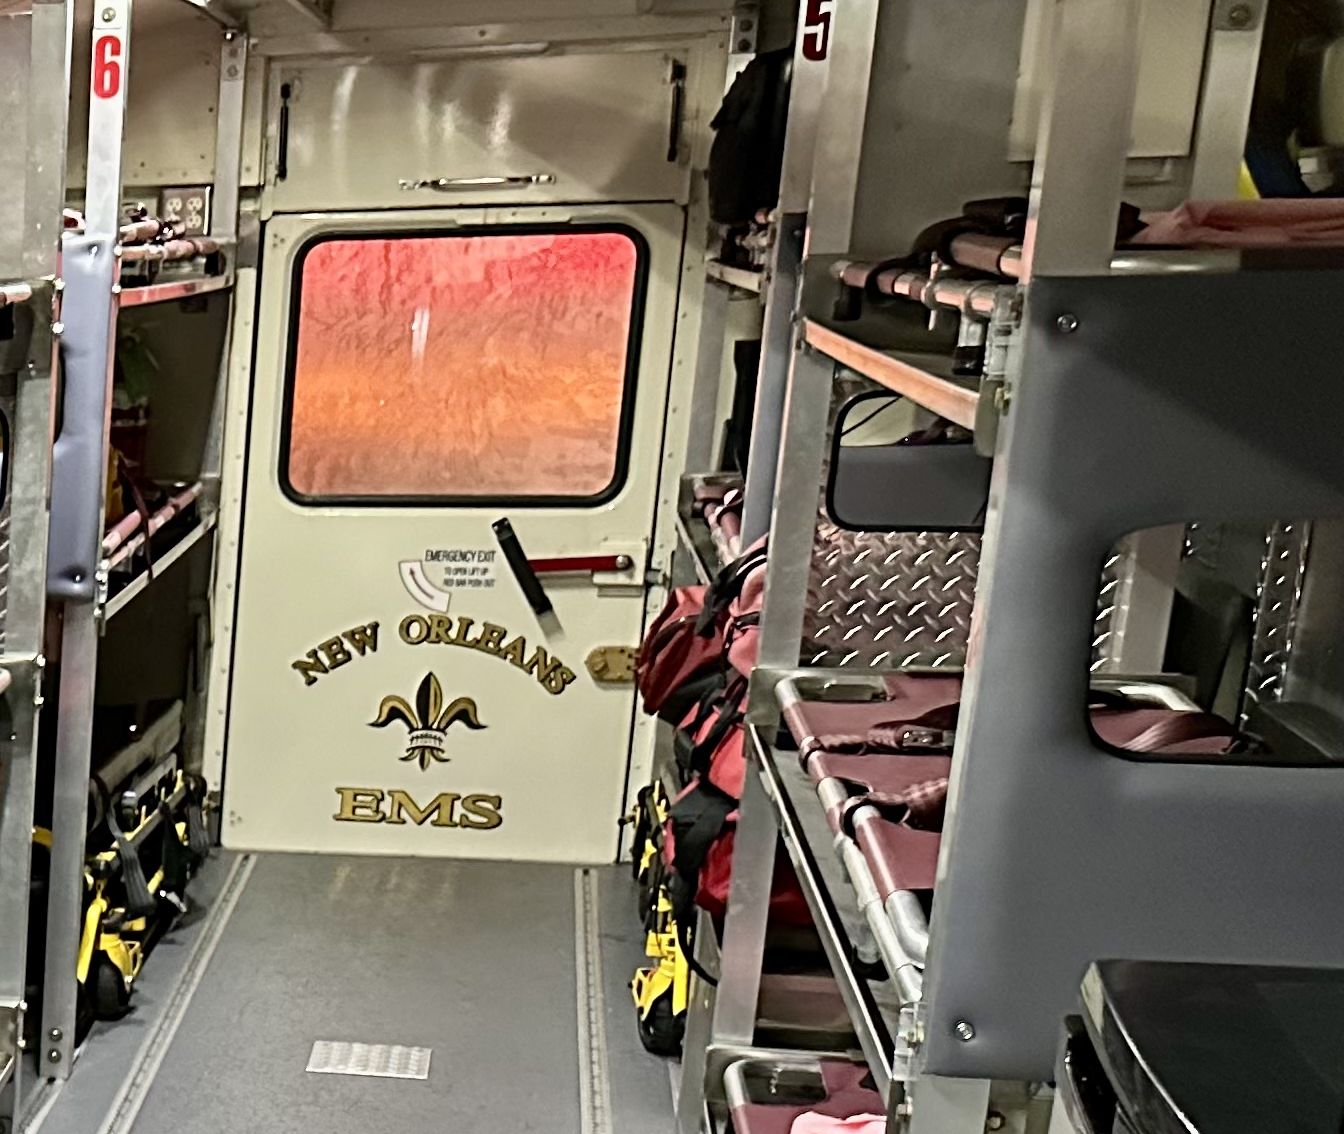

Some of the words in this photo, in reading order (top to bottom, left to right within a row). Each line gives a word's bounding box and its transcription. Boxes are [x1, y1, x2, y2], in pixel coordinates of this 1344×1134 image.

[802, 0, 832, 62] 5
[94, 35, 121, 99] 6
[425, 549, 476, 562] EMERGENCY
[477, 550, 496, 562] EXIT
[291, 621, 379, 686] NEW
[398, 614, 577, 695] ORLEANS
[332, 787, 503, 829] EMS
